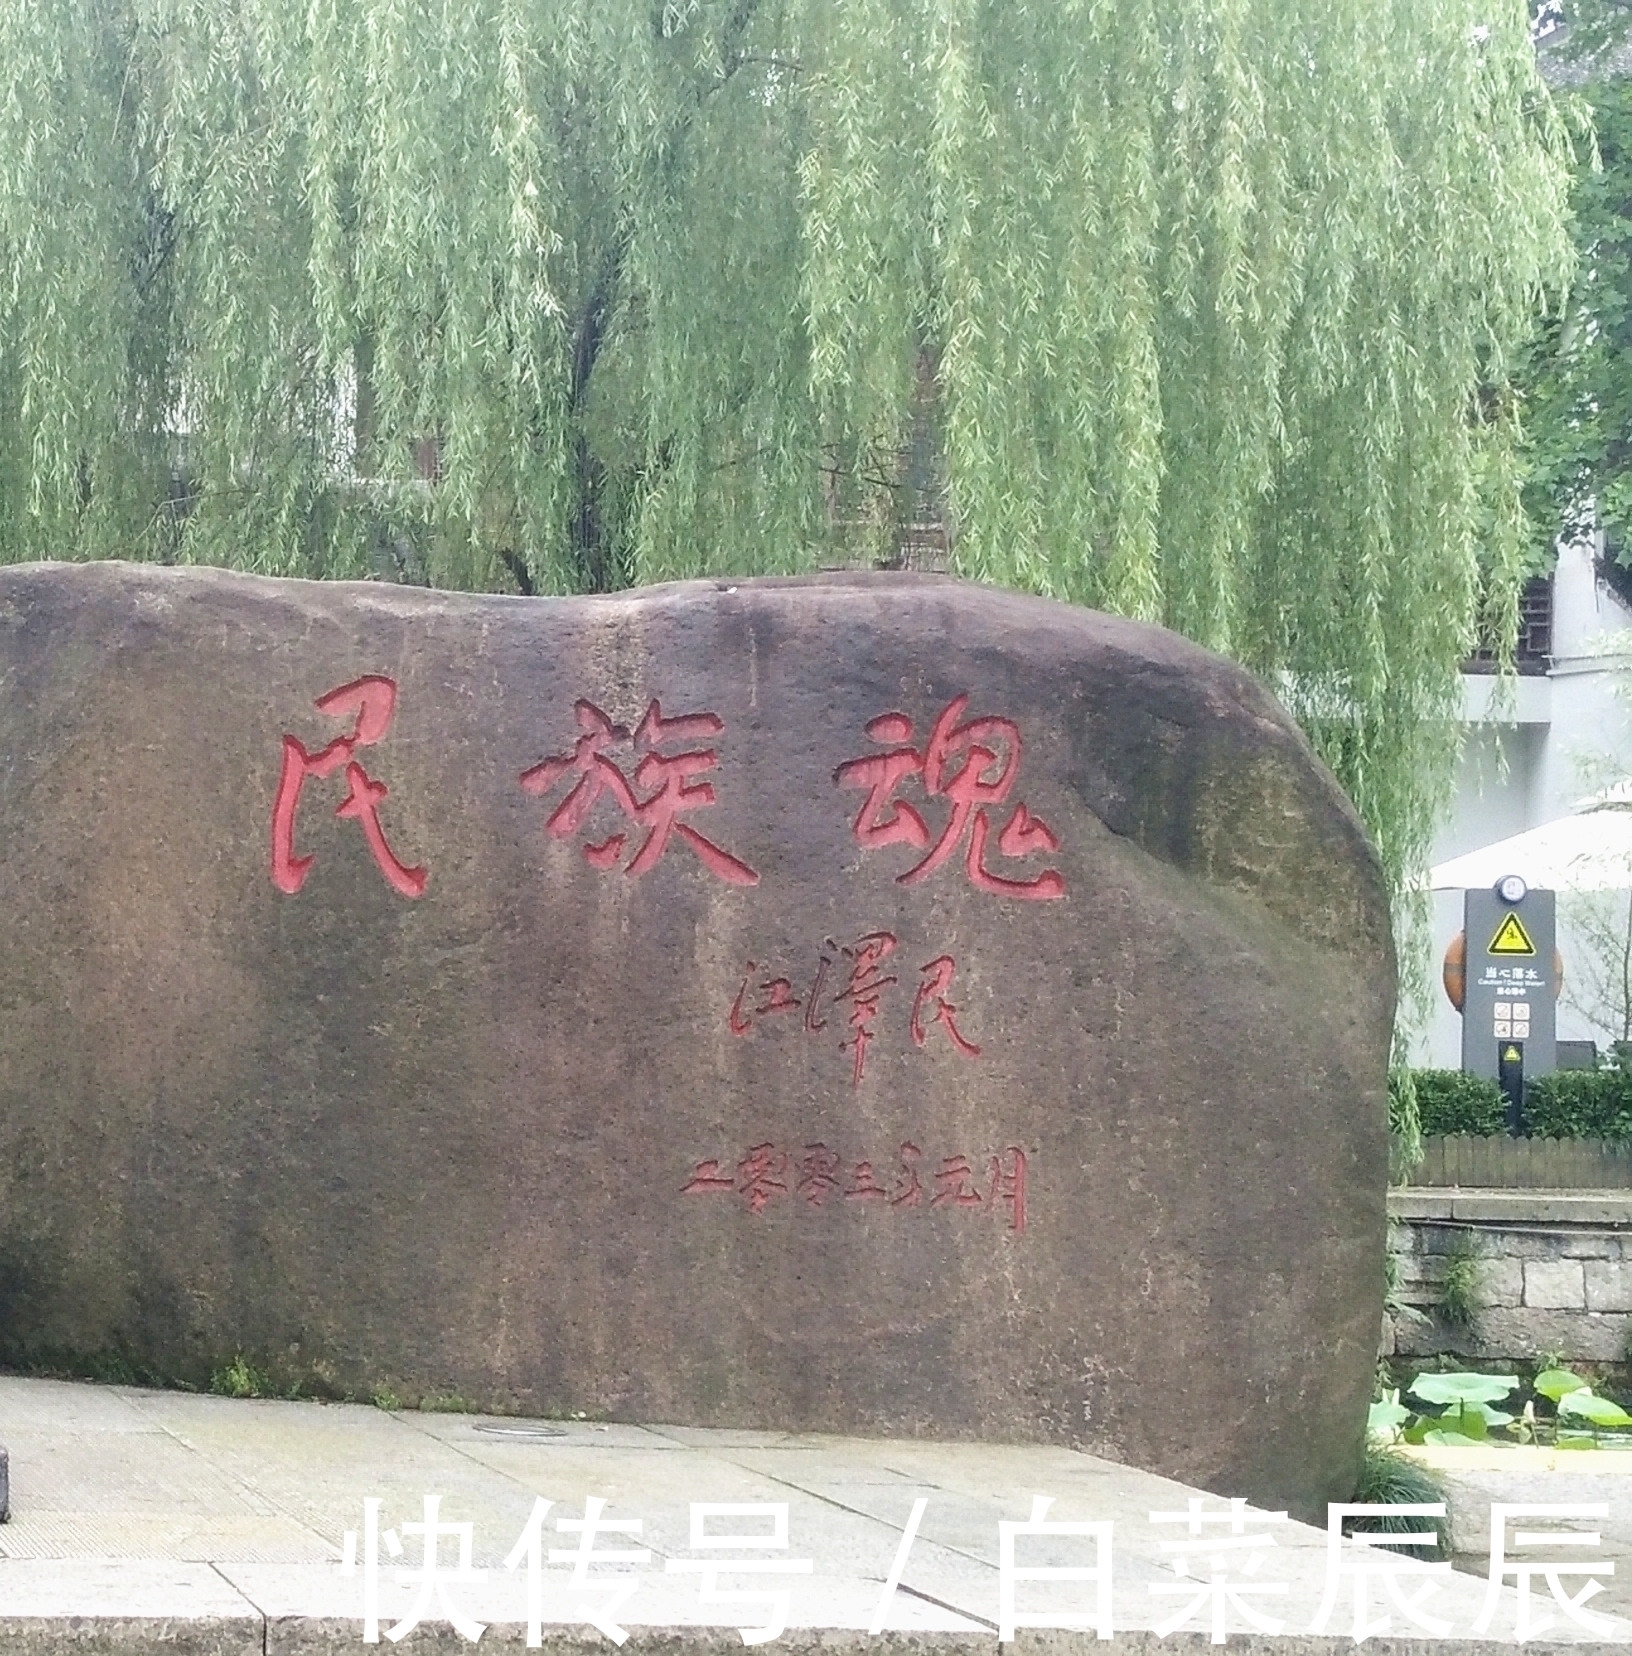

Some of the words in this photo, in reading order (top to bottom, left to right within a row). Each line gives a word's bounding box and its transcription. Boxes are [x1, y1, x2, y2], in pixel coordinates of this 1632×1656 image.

[271, 674, 1067, 901] 民族魂
[1485, 966, 1538, 980] 当心落水
